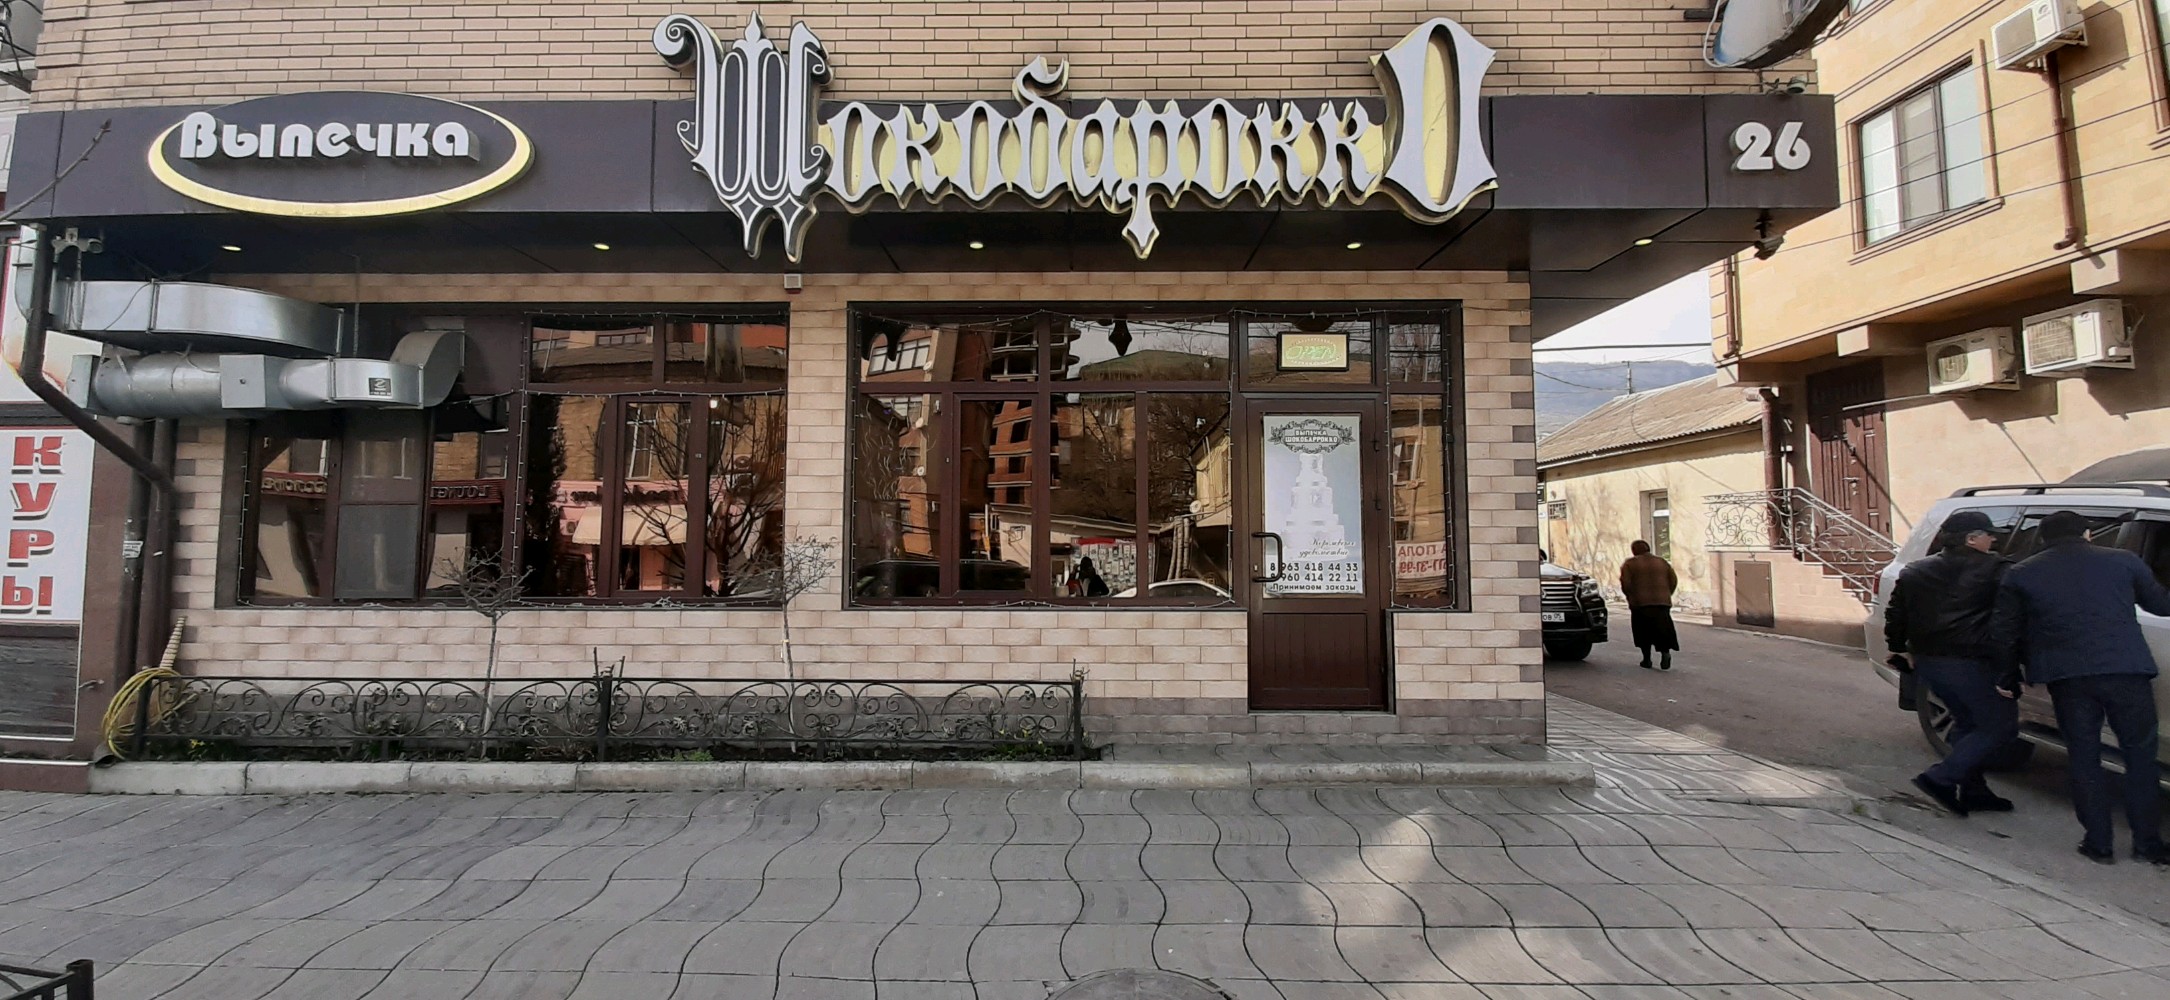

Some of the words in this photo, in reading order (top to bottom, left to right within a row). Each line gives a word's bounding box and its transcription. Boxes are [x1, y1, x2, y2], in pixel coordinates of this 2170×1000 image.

[180, 111, 472, 158] Выпечка
[1733, 121, 1811, 171] 26
[1286, 345, 1335, 360] OPEN
[1, 436, 63, 614] КУРЫ
[1270, 562, 1276, 571] 8
[1281, 562, 1300, 571] 963
[1304, 562, 1324, 571] 418
[1328, 562, 1341, 571] 44
[1346, 562, 1358, 571] 33
[1281, 573, 1300, 582] 960
[1304, 573, 1324, 582] 414
[1329, 573, 1341, 582] 22
[1346, 573, 1358, 582] 11
[1272, 583, 1322, 591] Принимаем
